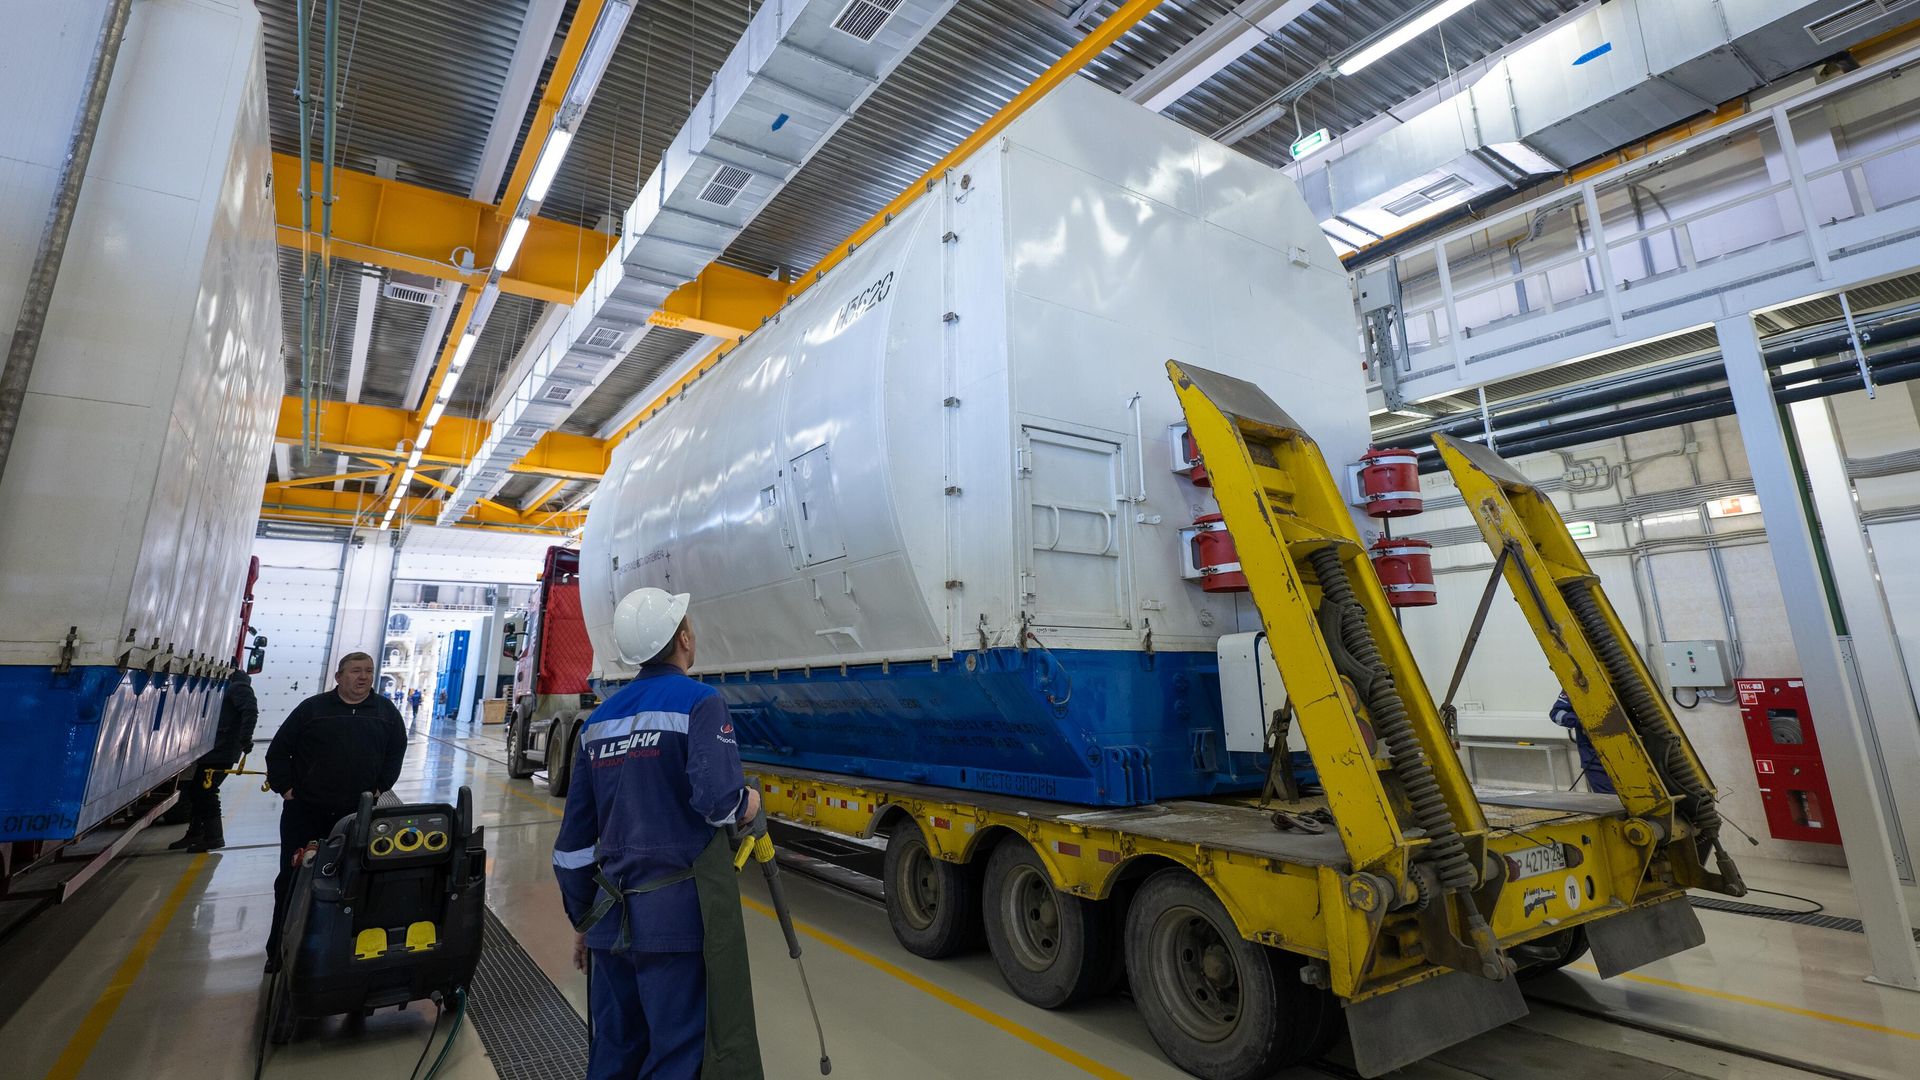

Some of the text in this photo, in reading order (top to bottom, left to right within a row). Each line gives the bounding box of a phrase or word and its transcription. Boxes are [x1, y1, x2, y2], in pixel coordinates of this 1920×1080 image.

[975, 770, 1056, 797] МЕСТО ОПОРЫ
[1525, 849, 1550, 873] 4279
